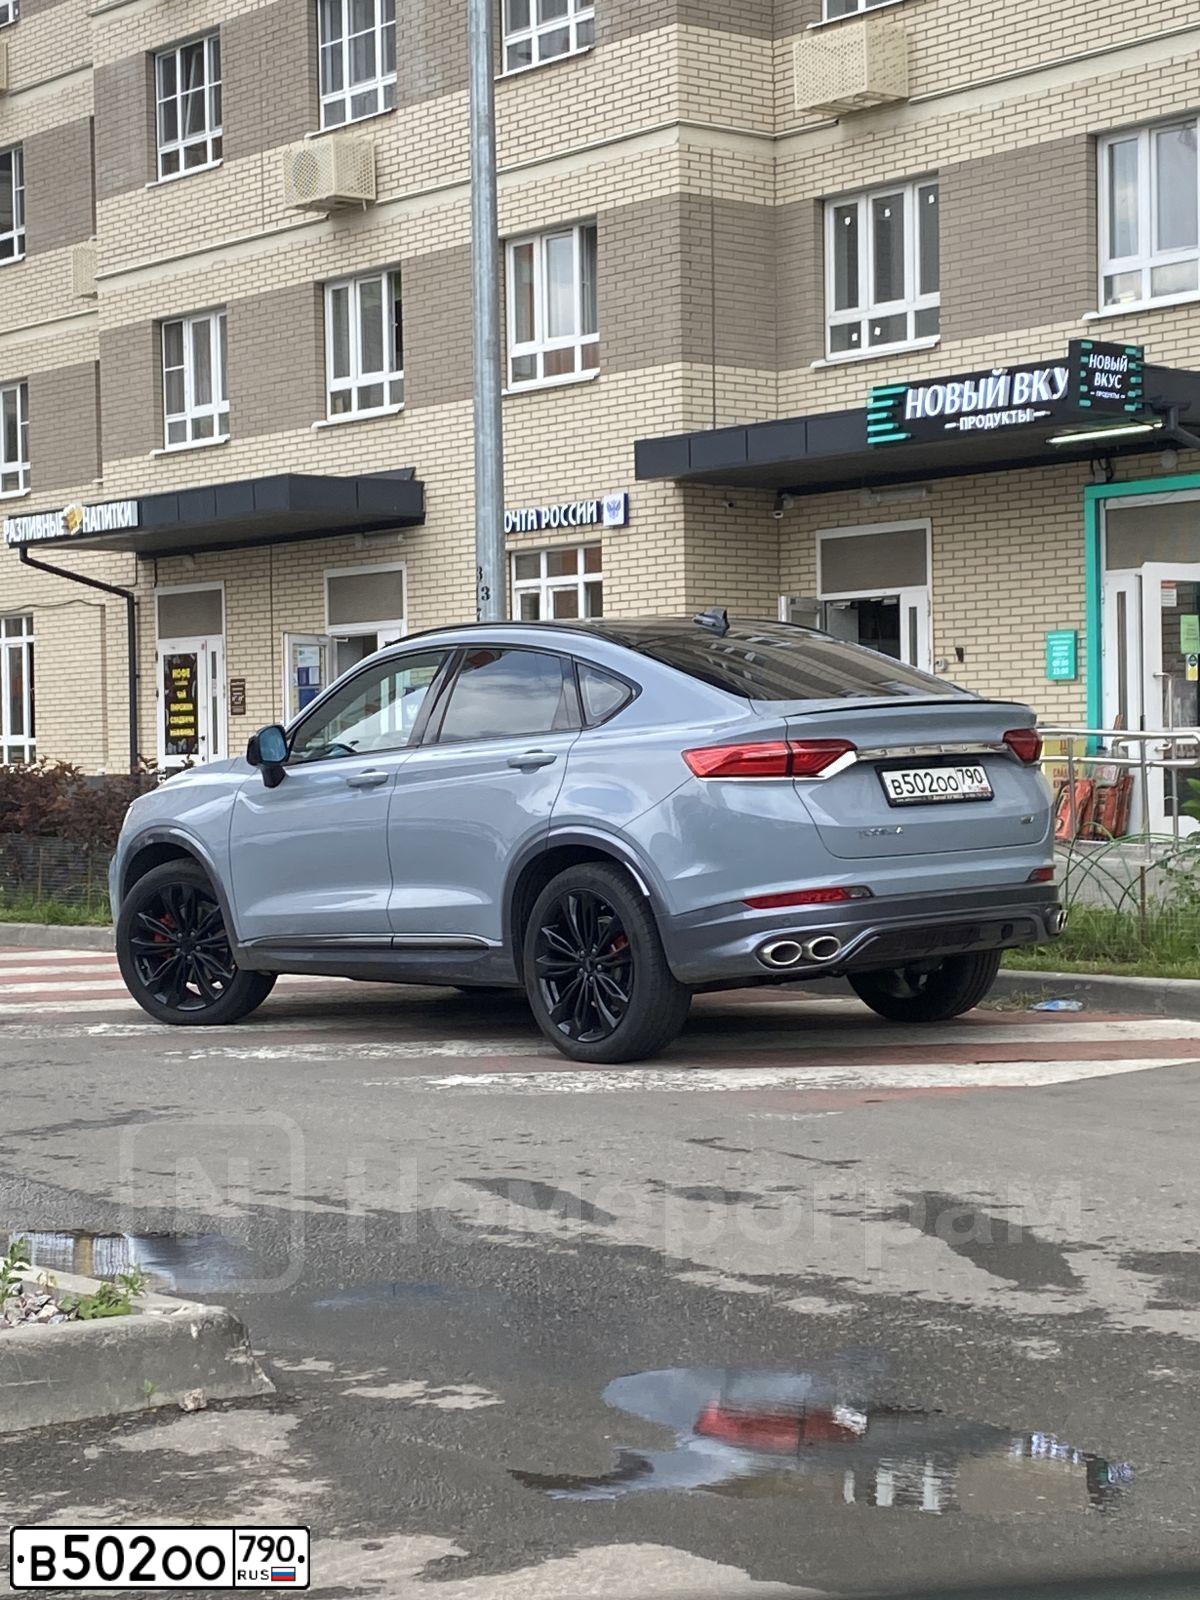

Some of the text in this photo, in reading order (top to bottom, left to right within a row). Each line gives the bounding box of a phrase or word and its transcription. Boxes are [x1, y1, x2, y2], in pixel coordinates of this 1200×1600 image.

[1089, 354, 1128, 372] НОВЫЙ
[1094, 372, 1122, 389] ВКУС
[905, 367, 1069, 420] НОВЫЙ ВКУ
[959, 409, 1032, 431] ПРОДУКТЫ
[82, 500, 138, 533] НАПИТКИ
[504, 500, 598, 533] ОЧТА РОССИИ
[955, 768, 983, 785] 790
